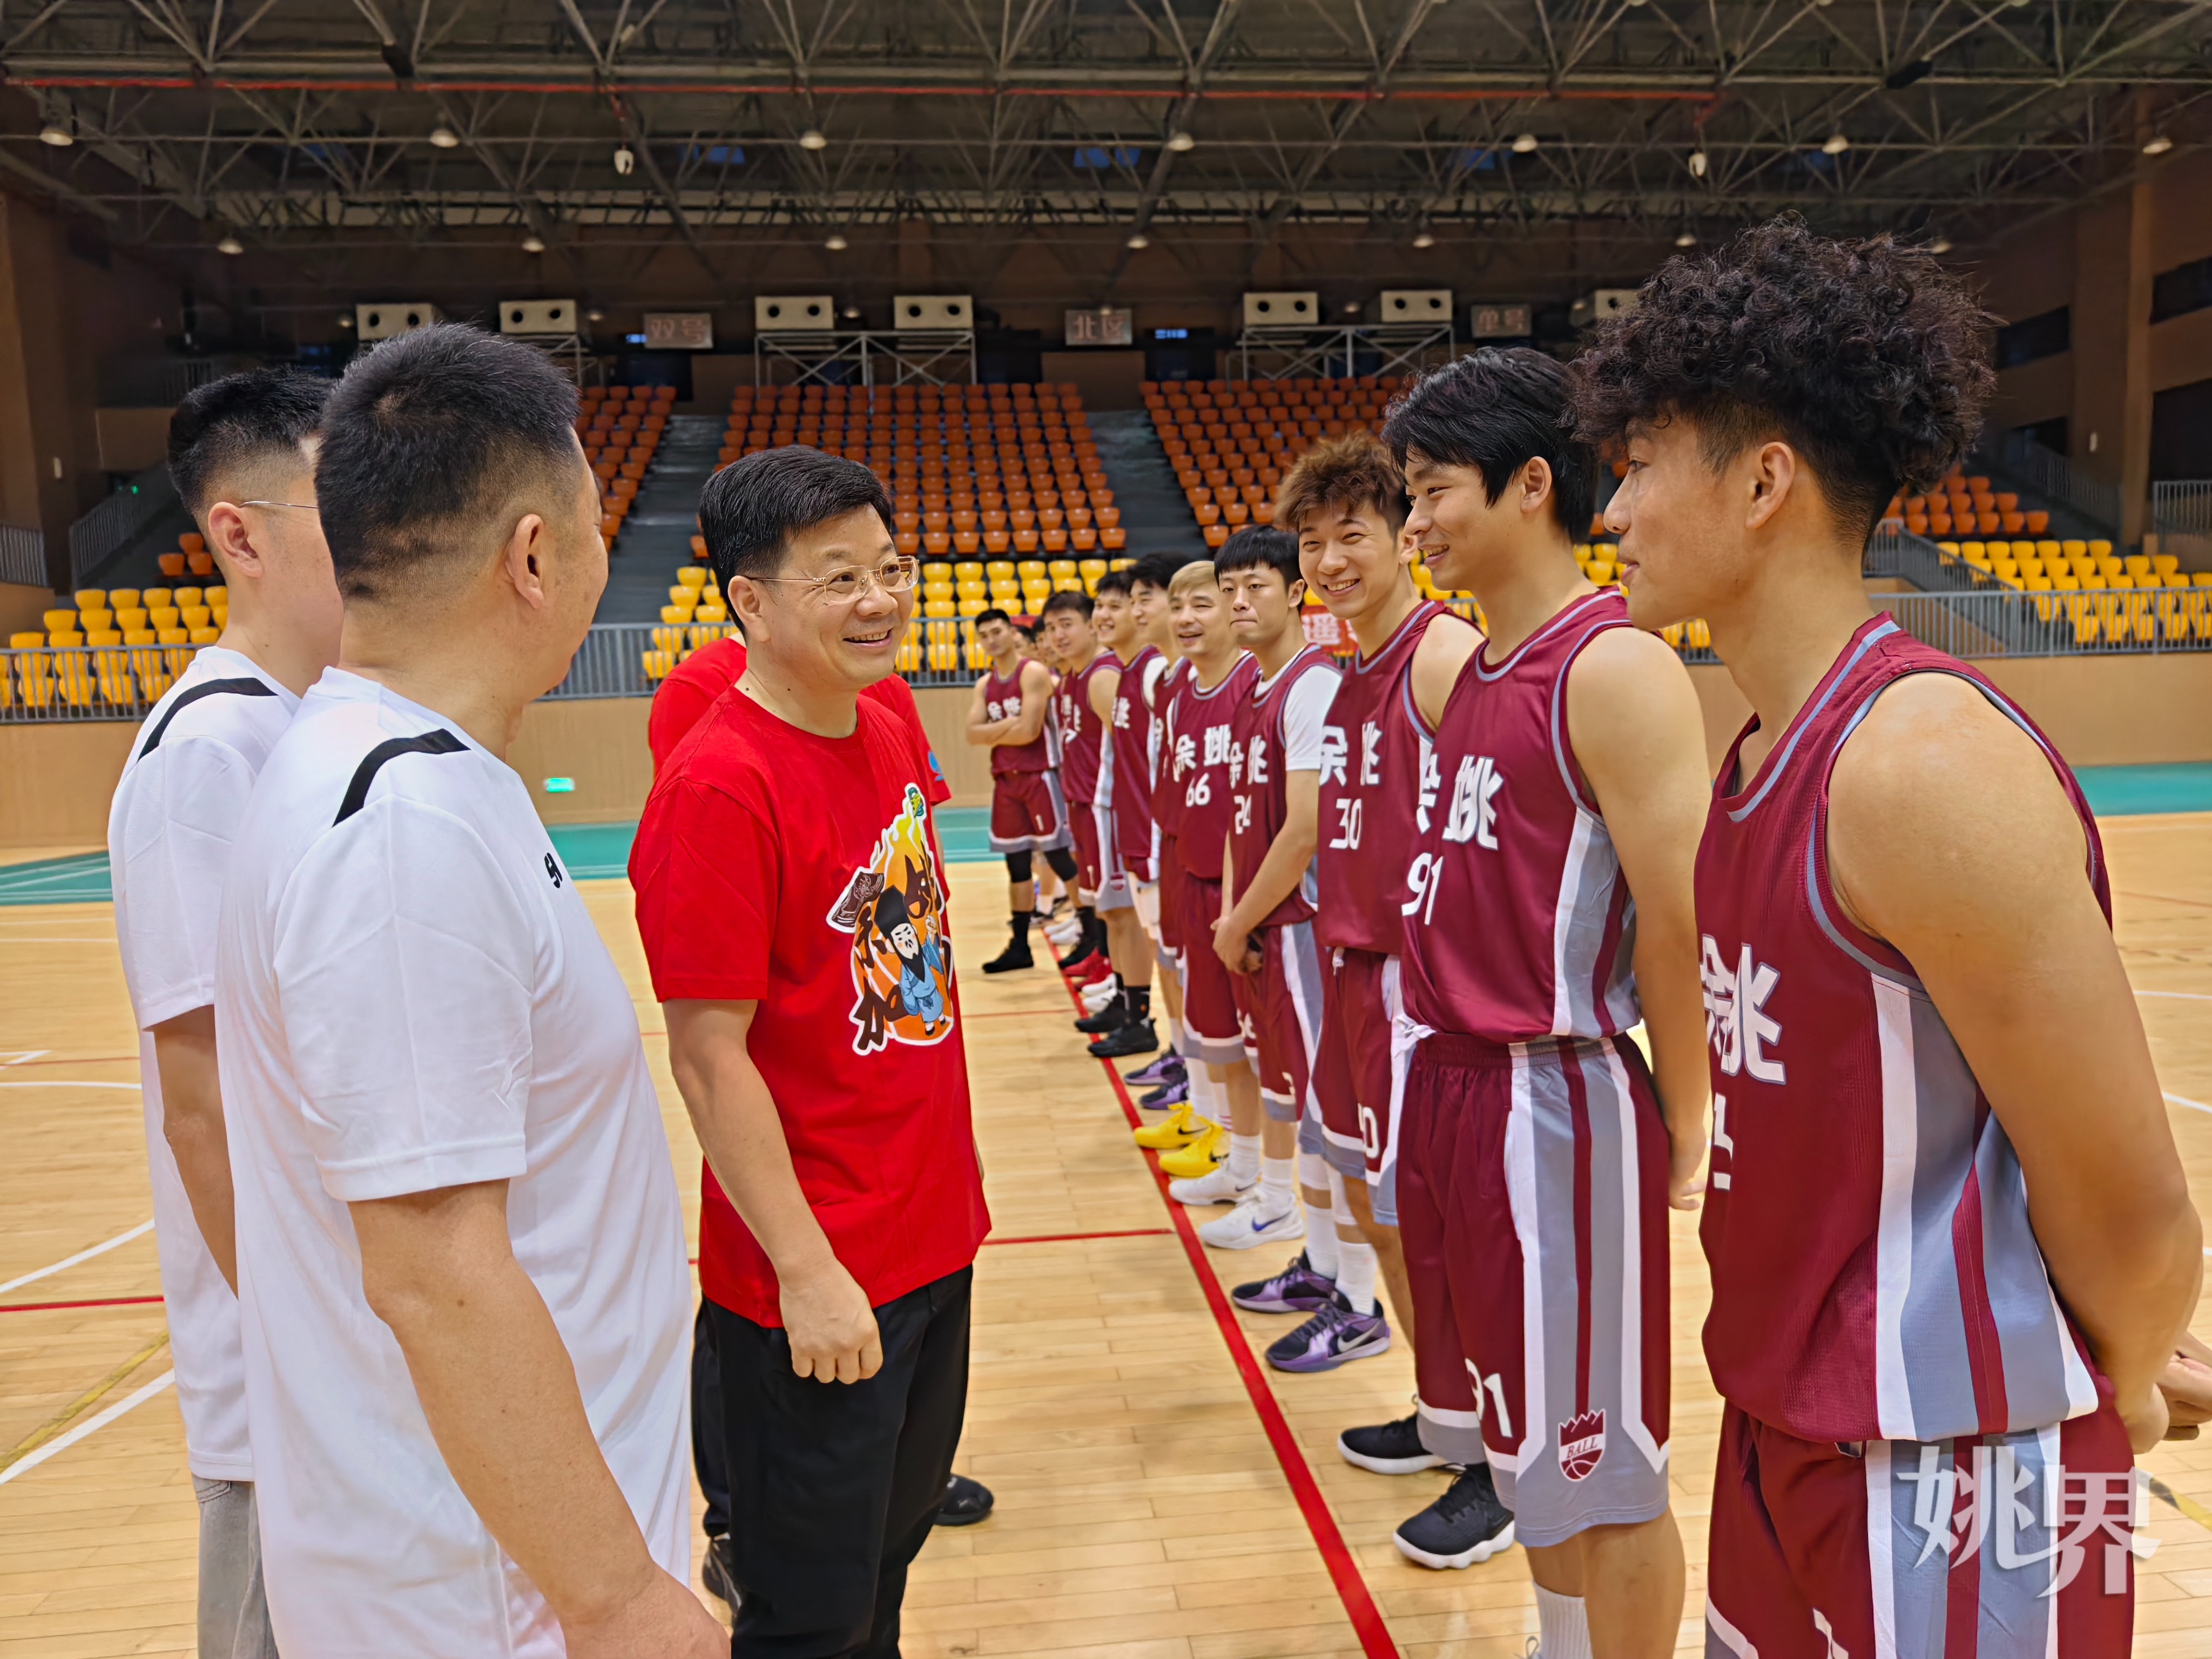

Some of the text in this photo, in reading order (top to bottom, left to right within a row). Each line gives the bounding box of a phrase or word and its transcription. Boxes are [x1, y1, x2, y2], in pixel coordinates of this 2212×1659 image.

[650, 319, 705, 344] 双号
[1074, 314, 1124, 341] 北区
[1185, 772, 1211, 807] 66
[1328, 798, 1363, 851] 30
[1401, 852, 1445, 926] 91
[1358, 1102, 1379, 1159] 0
[1567, 1436, 1598, 1458] BALL
